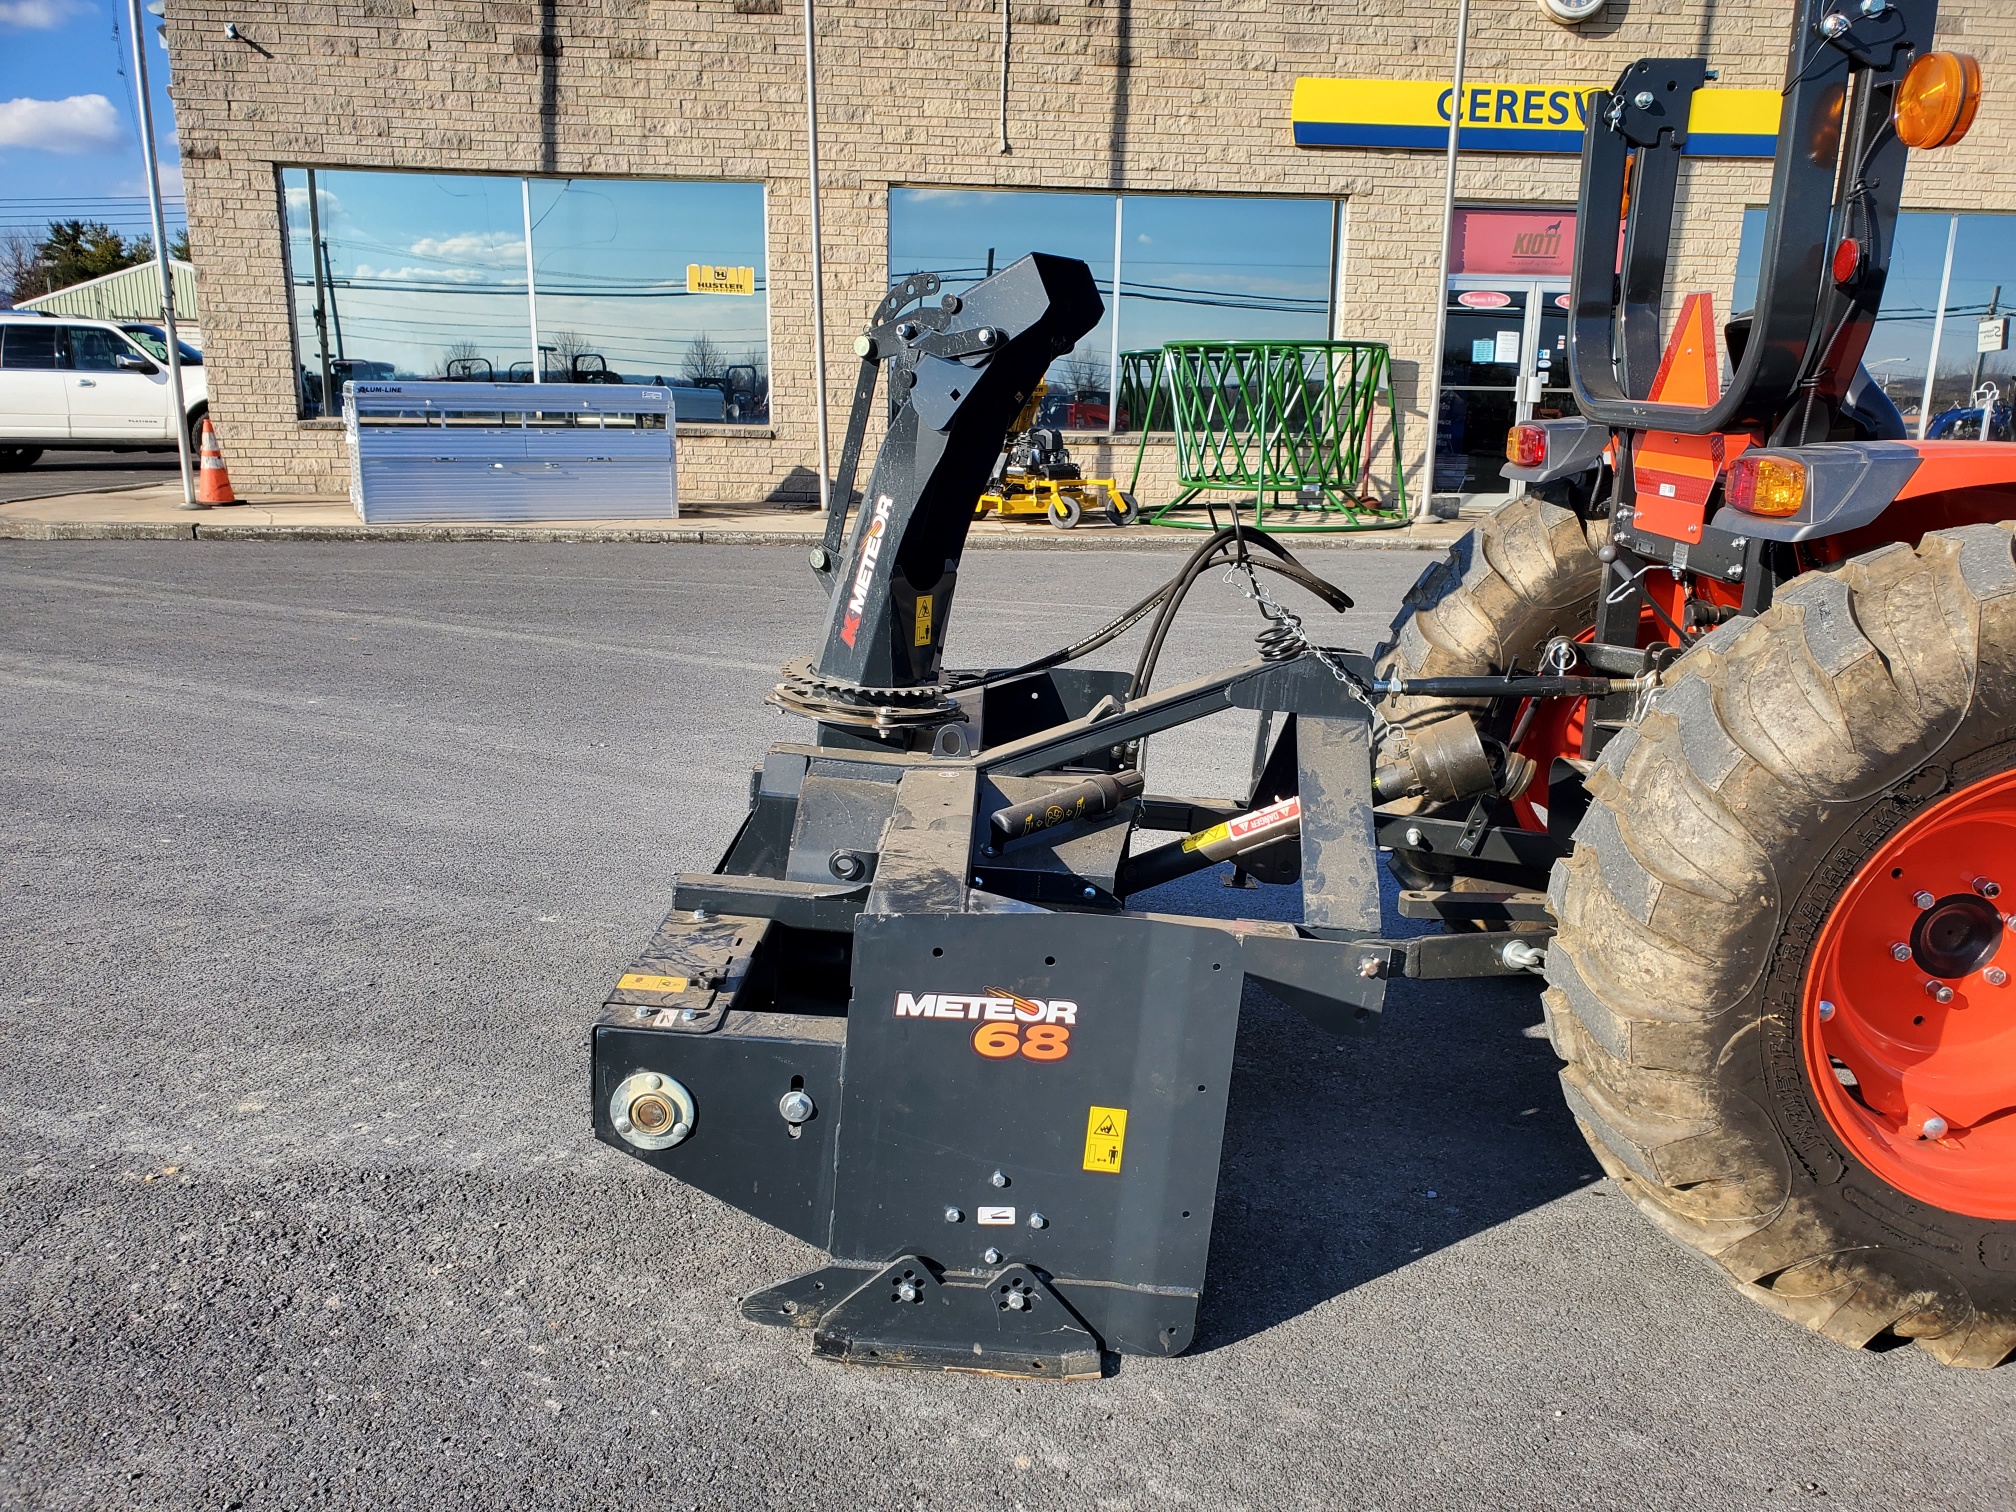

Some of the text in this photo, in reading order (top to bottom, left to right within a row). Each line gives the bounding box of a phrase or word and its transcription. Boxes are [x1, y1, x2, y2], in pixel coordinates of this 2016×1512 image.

[1512, 232, 1562, 255] KIOTI
[849, 494, 894, 615] METEOR
[1249, 811, 1281, 829] DANGER
[895, 990, 1079, 1025] METEOR
[974, 1021, 1071, 1060] 68
